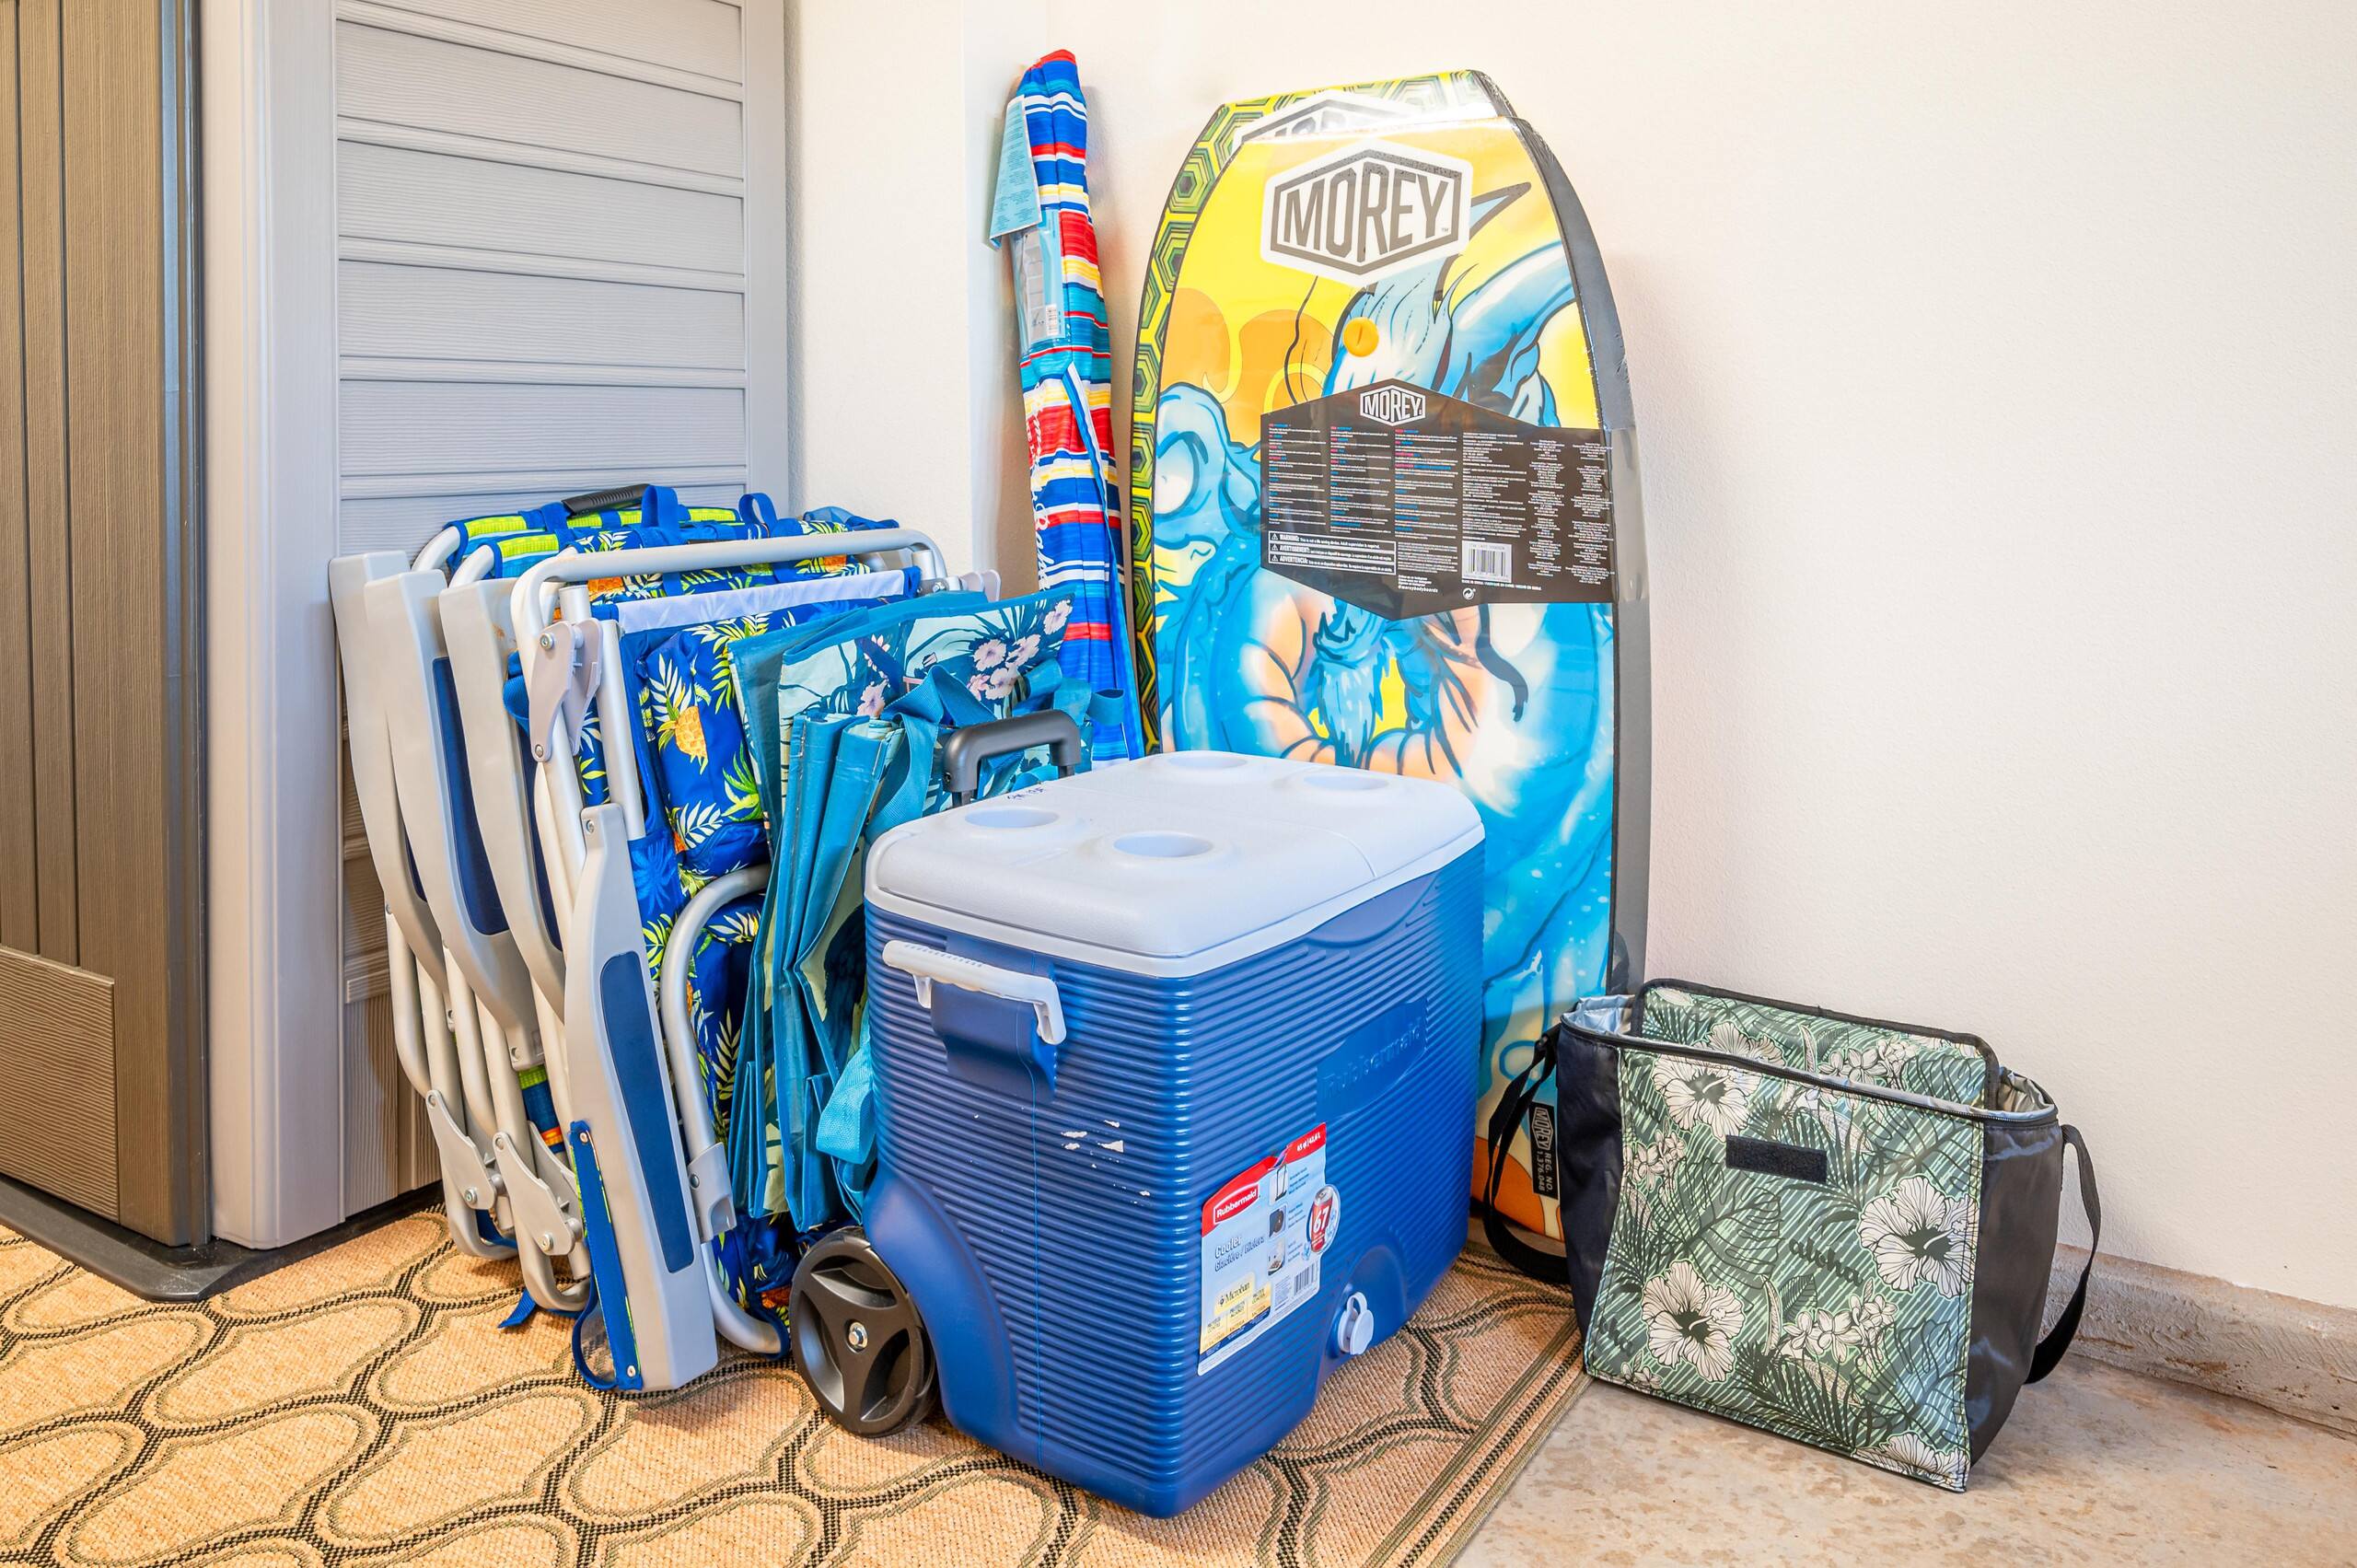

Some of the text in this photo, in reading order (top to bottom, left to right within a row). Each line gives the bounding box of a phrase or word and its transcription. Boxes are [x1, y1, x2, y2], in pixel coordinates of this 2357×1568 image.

[1283, 161, 1448, 263] MOREY
[1364, 389, 1422, 423] MOREY
[1535, 1109, 1551, 1150] MOREY
[1216, 1189, 1257, 1218] Rubbermaid
[1313, 1206, 1329, 1234] 67
[1215, 1237, 1242, 1259] Cooler
[1789, 1237, 1864, 1287] aloha
